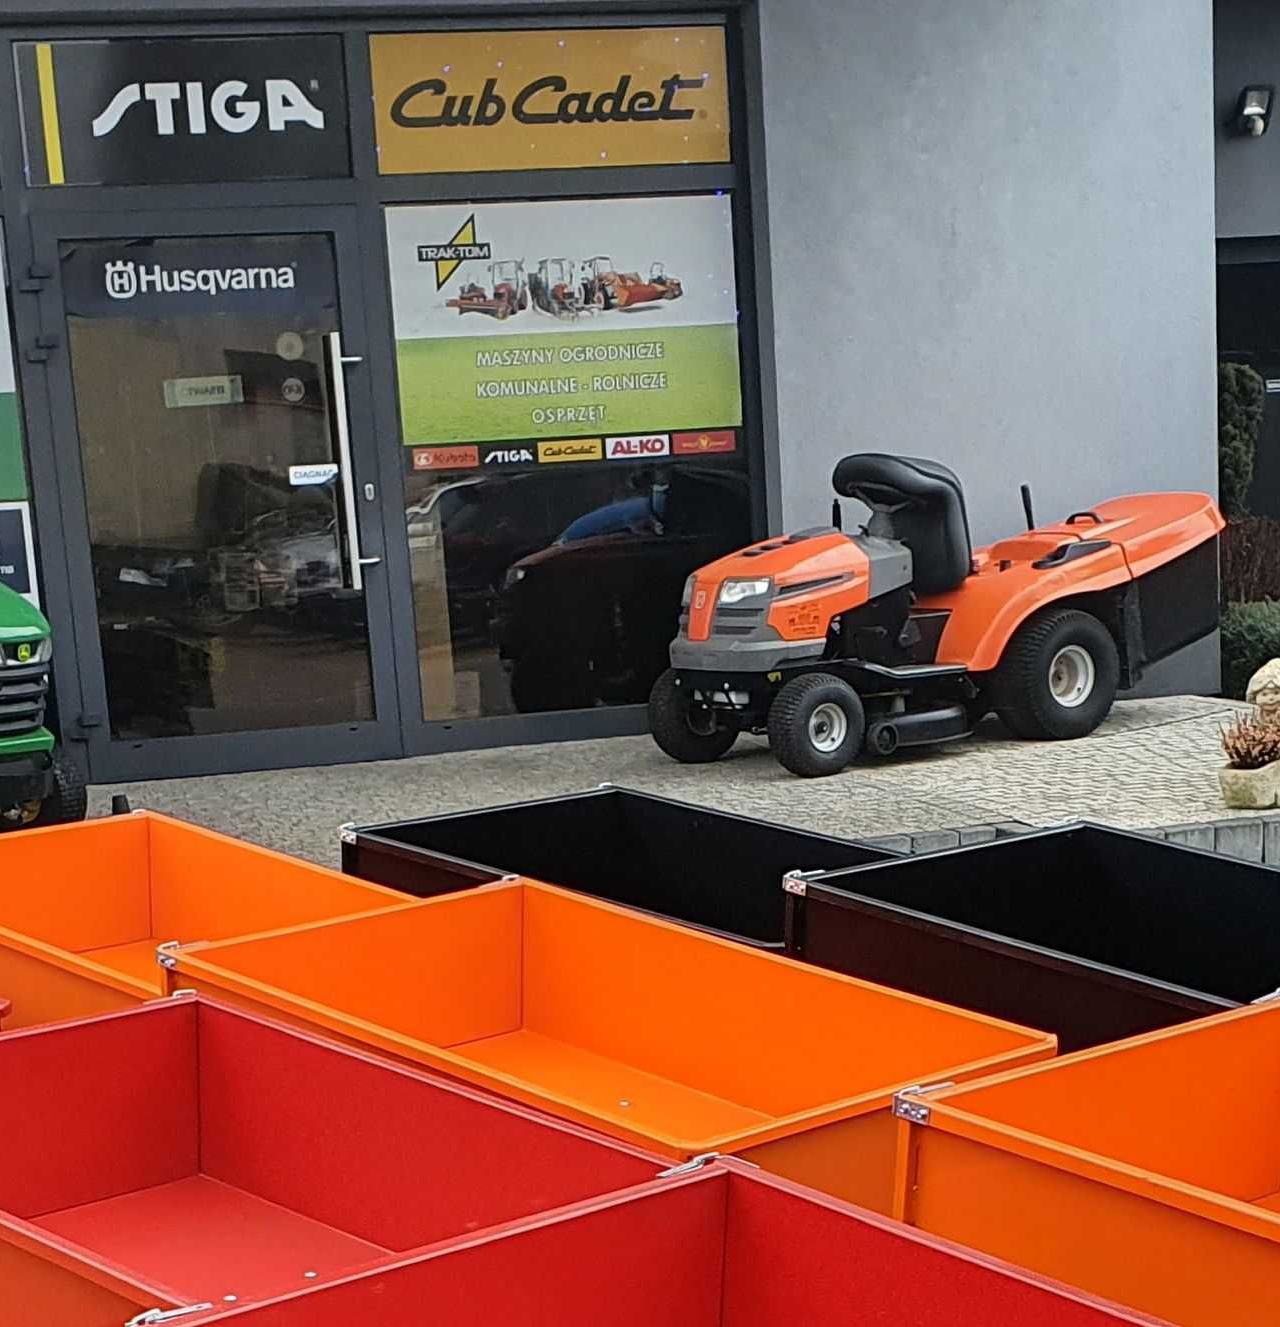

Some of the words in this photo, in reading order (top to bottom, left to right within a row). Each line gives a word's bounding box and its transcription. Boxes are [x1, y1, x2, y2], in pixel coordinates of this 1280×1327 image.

[92, 79, 325, 137] STIGA
[390, 78, 507, 128] Cub
[511, 74, 706, 124] Cadet
[139, 264, 296, 296] Husqvarna
[475, 347, 555, 367] MASZYNY
[559, 342, 665, 363] OGRODNICZE
[475, 376, 578, 399] KOMUNALNE
[592, 372, 668, 393] ROLNICZE
[532, 405, 607, 426] OSPRZĘT
[484, 449, 534, 464] STIGA
[611, 438, 665, 456] AL-KO
